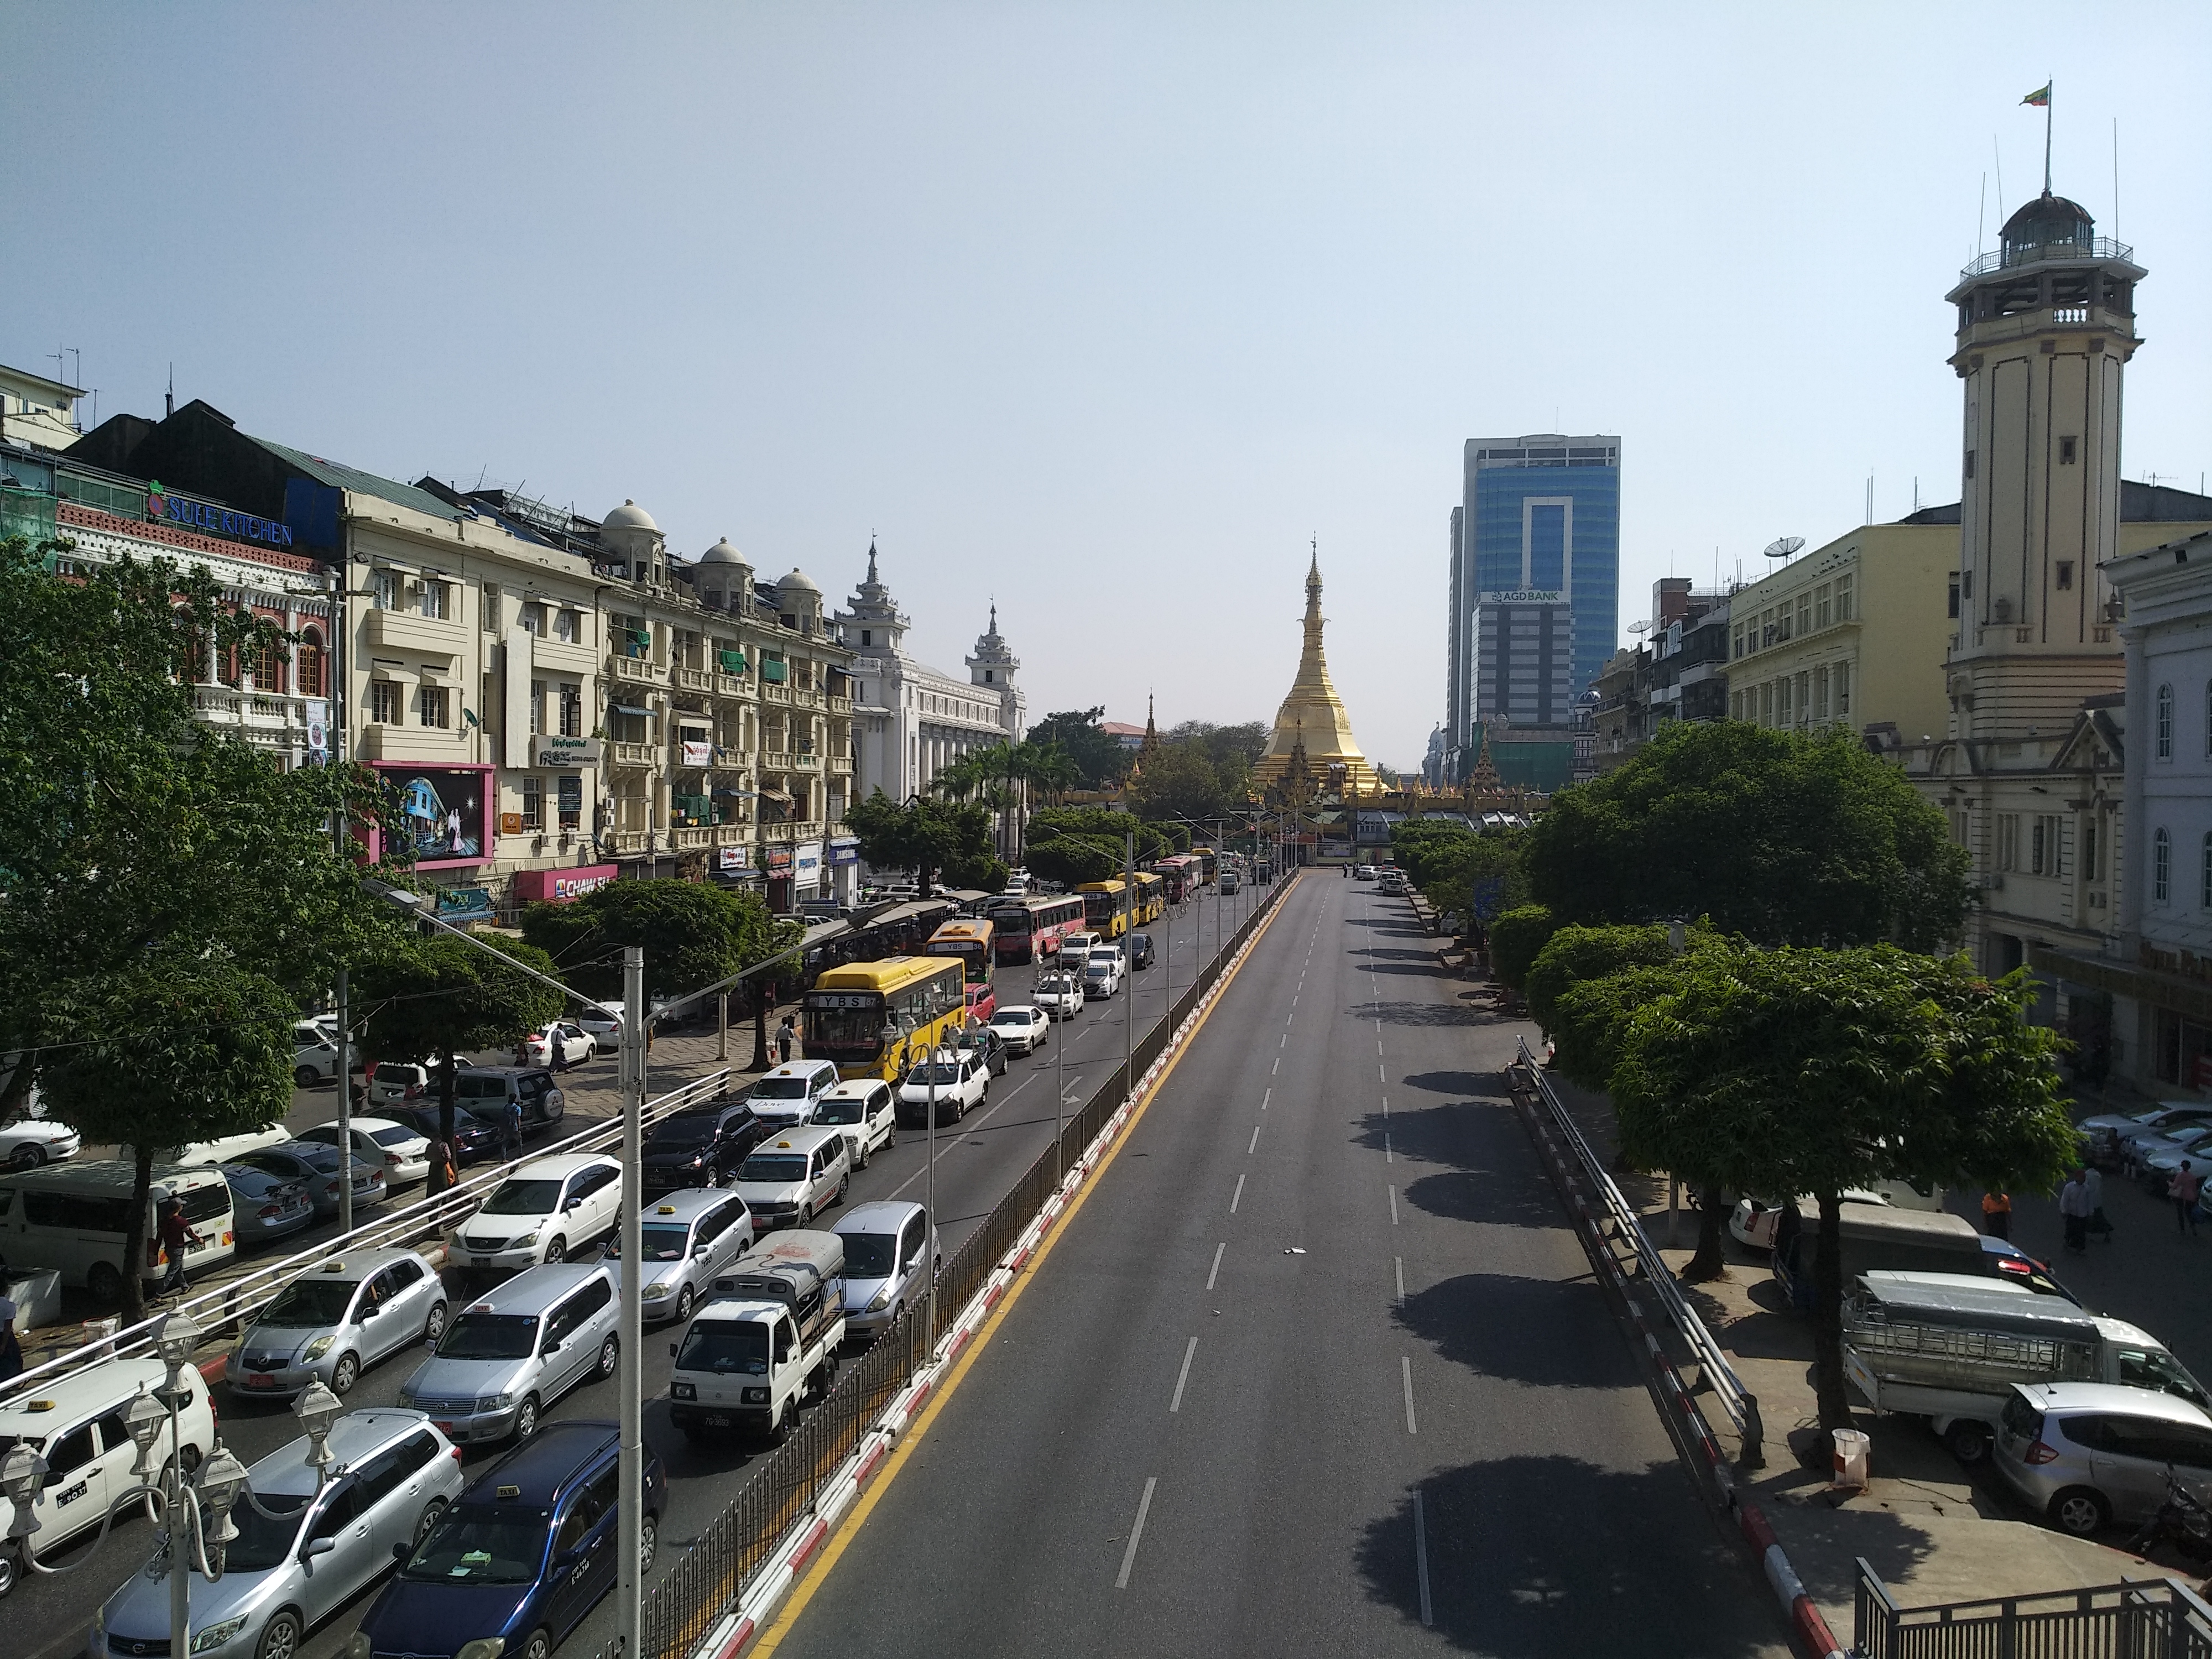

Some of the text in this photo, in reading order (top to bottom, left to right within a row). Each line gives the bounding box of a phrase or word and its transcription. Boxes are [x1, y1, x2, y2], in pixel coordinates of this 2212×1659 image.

[168, 497, 293, 546] SULE KITCHEN
[836, 849, 856, 860] SAMSUNG
[566, 877, 596, 897] CHAW
[866, 998, 876, 1006] 87
